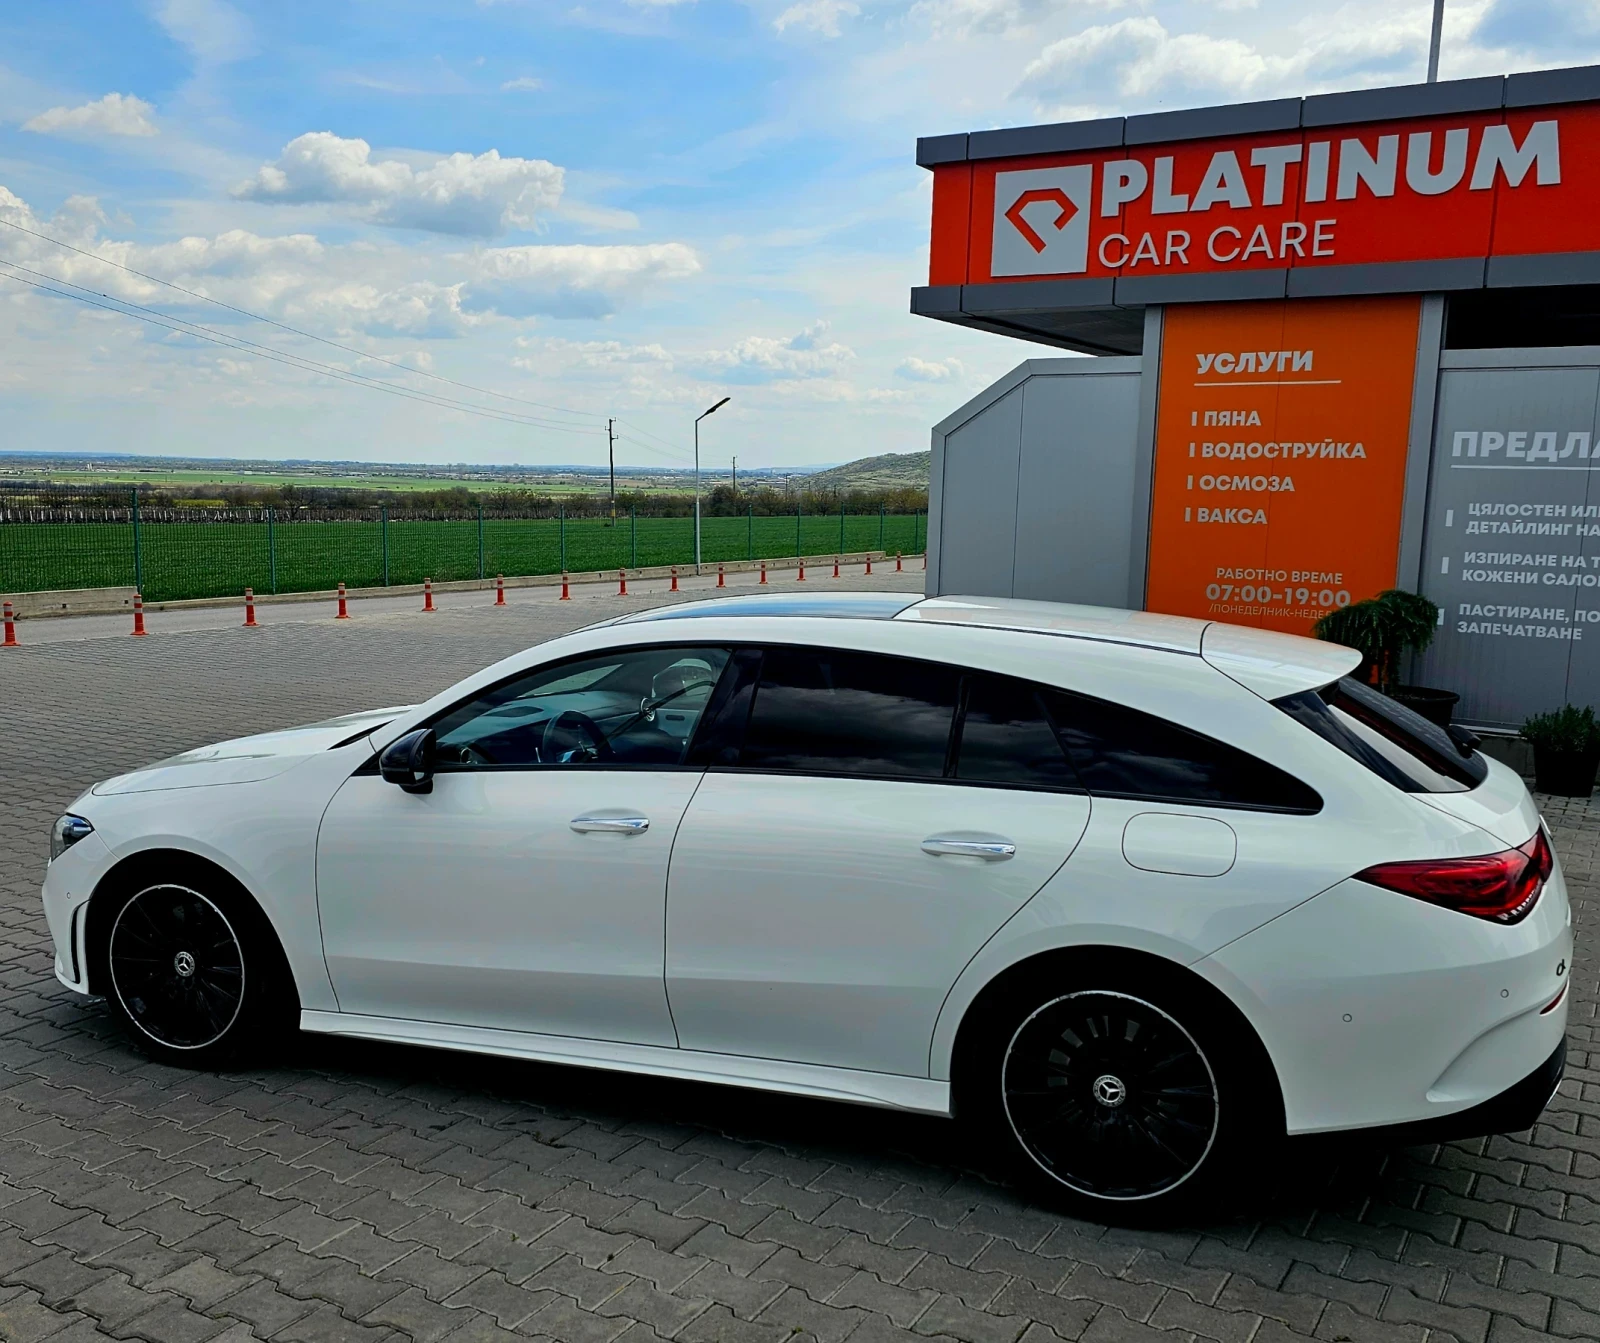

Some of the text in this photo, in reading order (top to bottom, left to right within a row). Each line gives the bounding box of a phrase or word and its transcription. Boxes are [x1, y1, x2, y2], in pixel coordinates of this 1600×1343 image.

[1100, 119, 1562, 218] PLATINUM
[1098, 218, 1337, 269] CAR CARE
[1196, 350, 1314, 374] УСЛУГИ
[1204, 410, 1262, 427] ПЯНА
[1202, 439, 1367, 460] ВОДОСТРУЙКА
[1199, 475, 1295, 492] ОСМОЗА
[1197, 507, 1268, 525] ВАКСА
[1469, 503, 1600, 518] ЦЯЛОСТЕН ИЛ
[1466, 519, 1600, 537] ДЕТАЙЛИНГ НА
[1464, 552, 1557, 568] ИЗПИРАНЕ
[1561, 555, 1587, 568] НА
[1216, 567, 1343, 585] РАБОТНО ВРЕМЕ
[1462, 569, 1600, 588] КОЖЕНИ САЛО
[1205, 583, 1351, 608] 07:00-19:00
[1459, 603, 1570, 624] ПАСТИРАНЕ,
[1457, 621, 1582, 641] ЗАПЕЧАТВАНЕ
